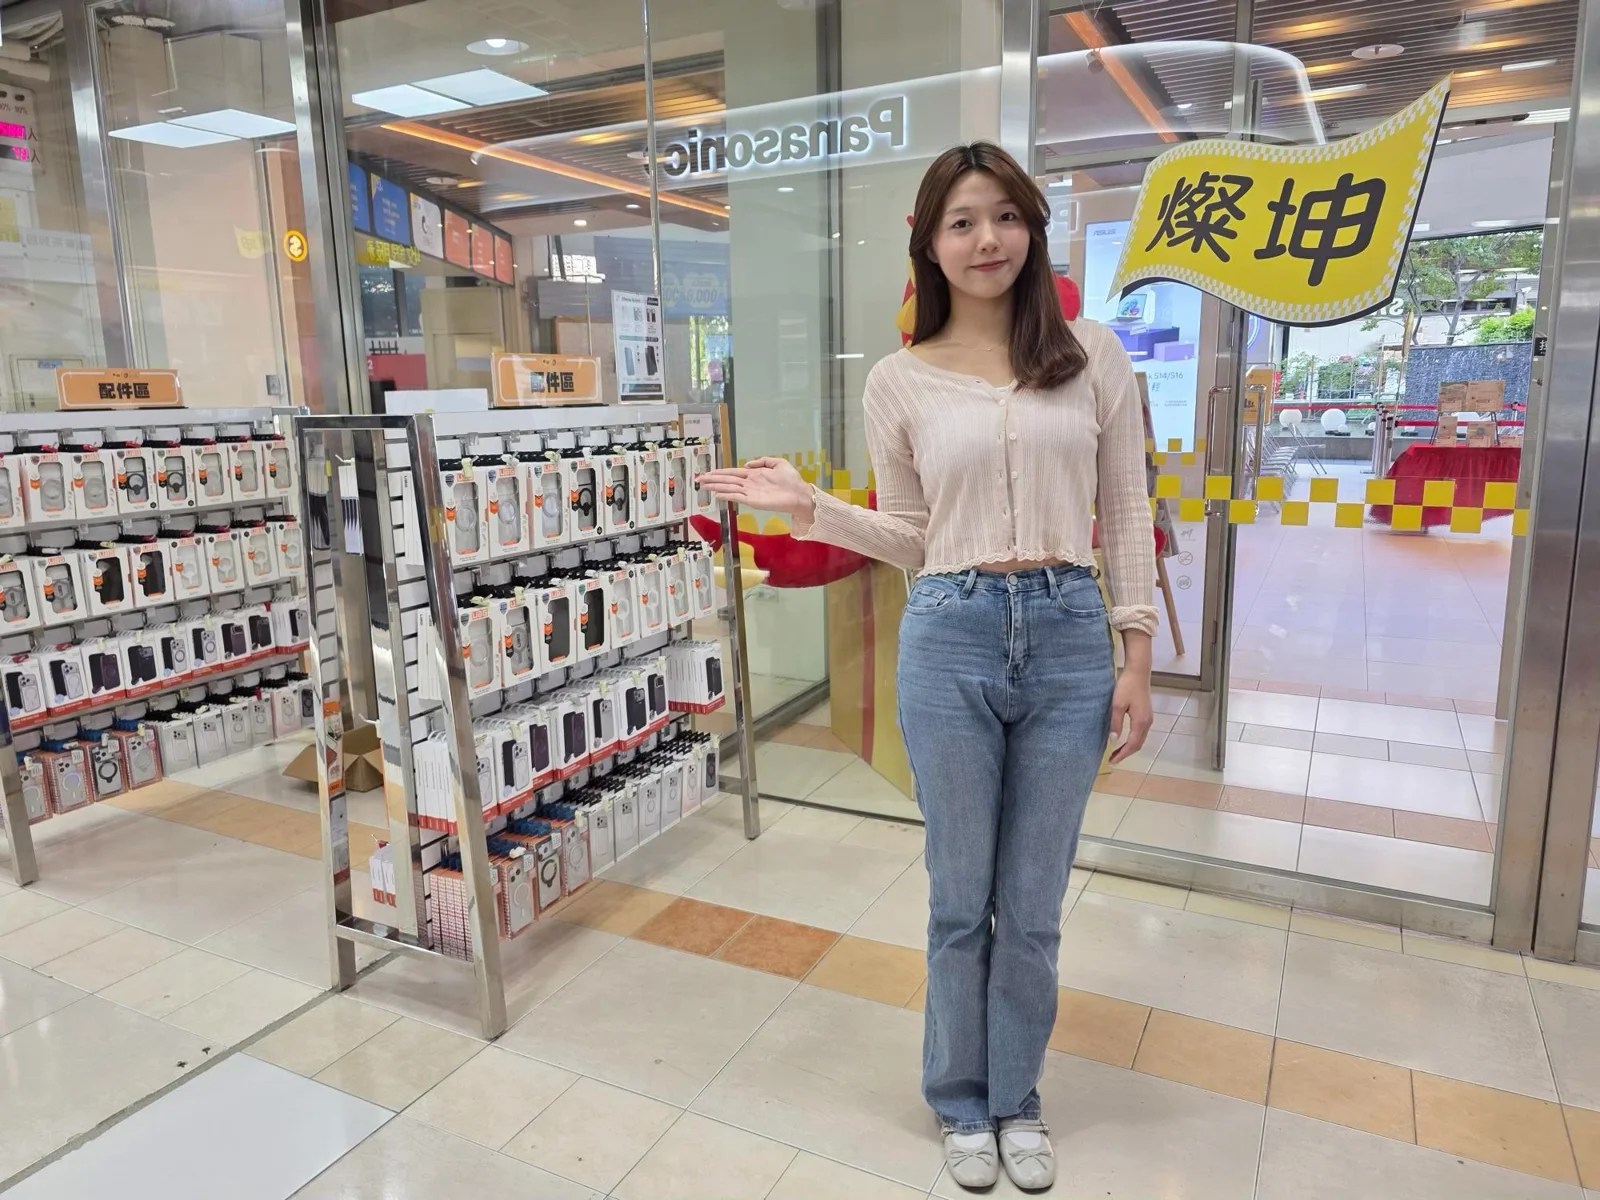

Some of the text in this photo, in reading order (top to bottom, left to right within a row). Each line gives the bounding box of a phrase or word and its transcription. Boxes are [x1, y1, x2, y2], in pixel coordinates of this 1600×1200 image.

[1145, 171, 1387, 287] 燦坤
[1154, 372, 1184, 381] S14/S16
[98, 382, 151, 399] 配件區
